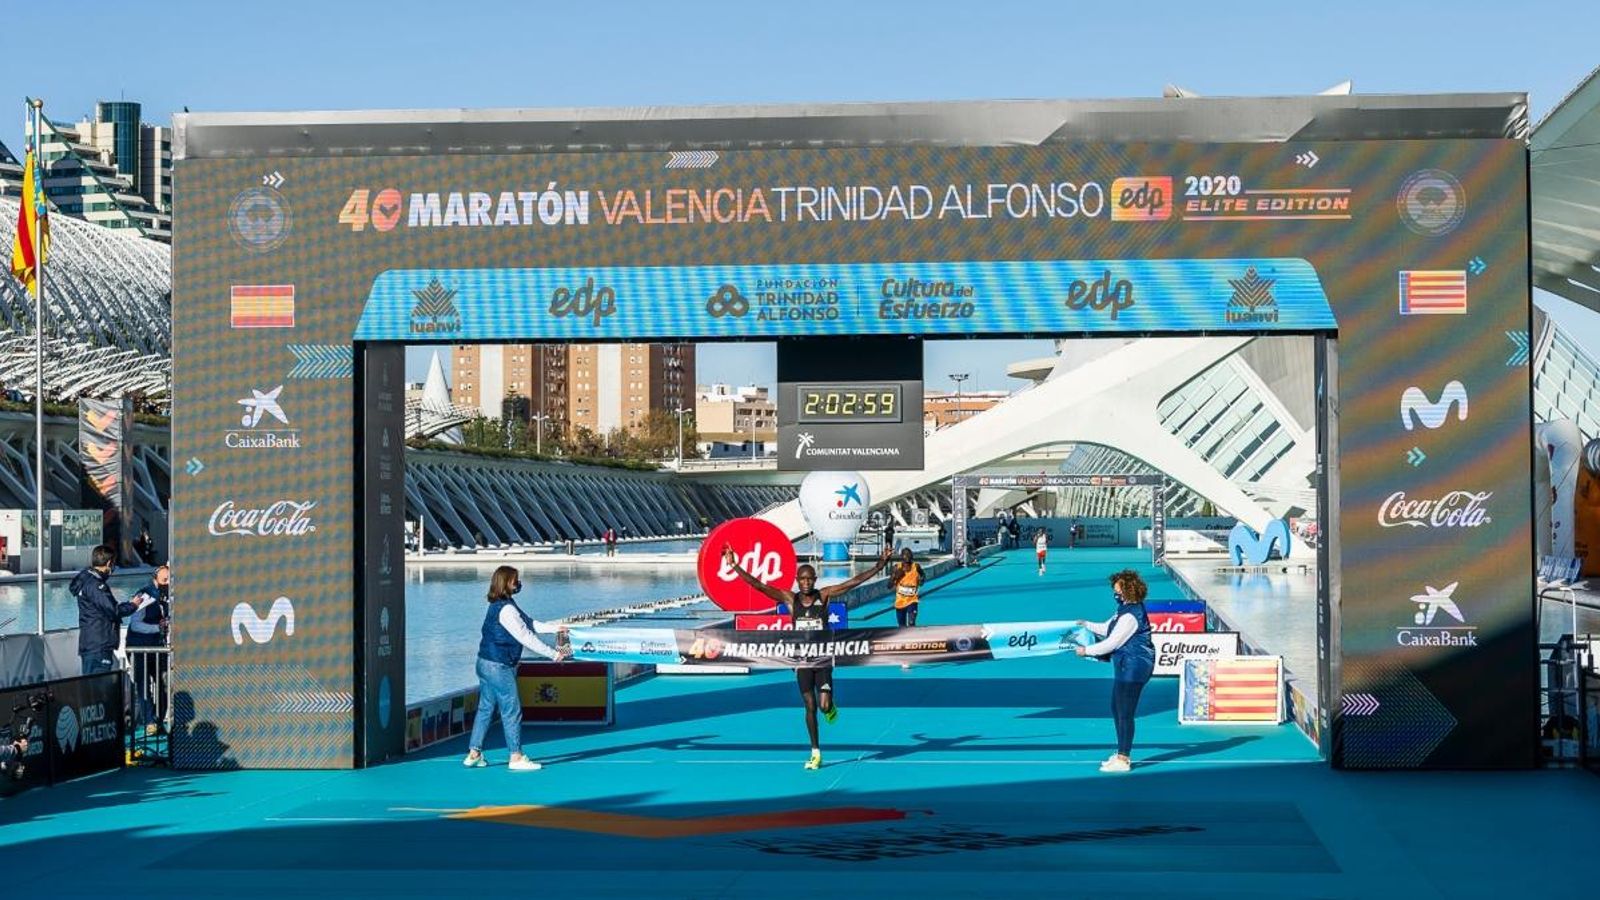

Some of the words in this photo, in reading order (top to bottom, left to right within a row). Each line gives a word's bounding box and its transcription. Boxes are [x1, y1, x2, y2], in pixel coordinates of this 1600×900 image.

[1184, 175, 1241, 196] 2020
[338, 187, 402, 232] 40
[407, 181, 589, 227] MARATÓN
[596, 187, 772, 224] VALENCIA
[770, 185, 933, 222] TRINIDAD
[937, 182, 1104, 219] ALFONSO
[1119, 181, 1163, 215] edp
[1186, 198, 1248, 212] ELITE
[1256, 197, 1349, 211] EDITION
[881, 277, 955, 298] Cultura
[955, 286, 975, 297] del
[1065, 270, 1135, 320] edp
[549, 276, 617, 327] edp
[756, 292, 839, 306] TRINIDAD
[878, 299, 975, 320] Esfuerzo
[756, 306, 839, 321] ALFONSO
[804, 393, 896, 415] 2:02:59
[225, 432, 300, 449] CaixaBank
[806, 447, 851, 456] COMUNITAT
[851, 447, 900, 456] VALENCIANA
[208, 499, 319, 536] Coca-Cola
[1377, 491, 1494, 528] Coca-Cola
[689, 637, 722, 659] 40
[723, 639, 799, 657] MARATÓN
[800, 640, 870, 657] VALENCIA
[905, 642, 946, 650] EDITION
[1008, 631, 1038, 651] edp
[1161, 642, 1208, 654] Cultura
[1397, 631, 1478, 647] CaixaBank
[80, 703, 105, 722] WORLD
[81, 721, 117, 745] ATHLETICS
